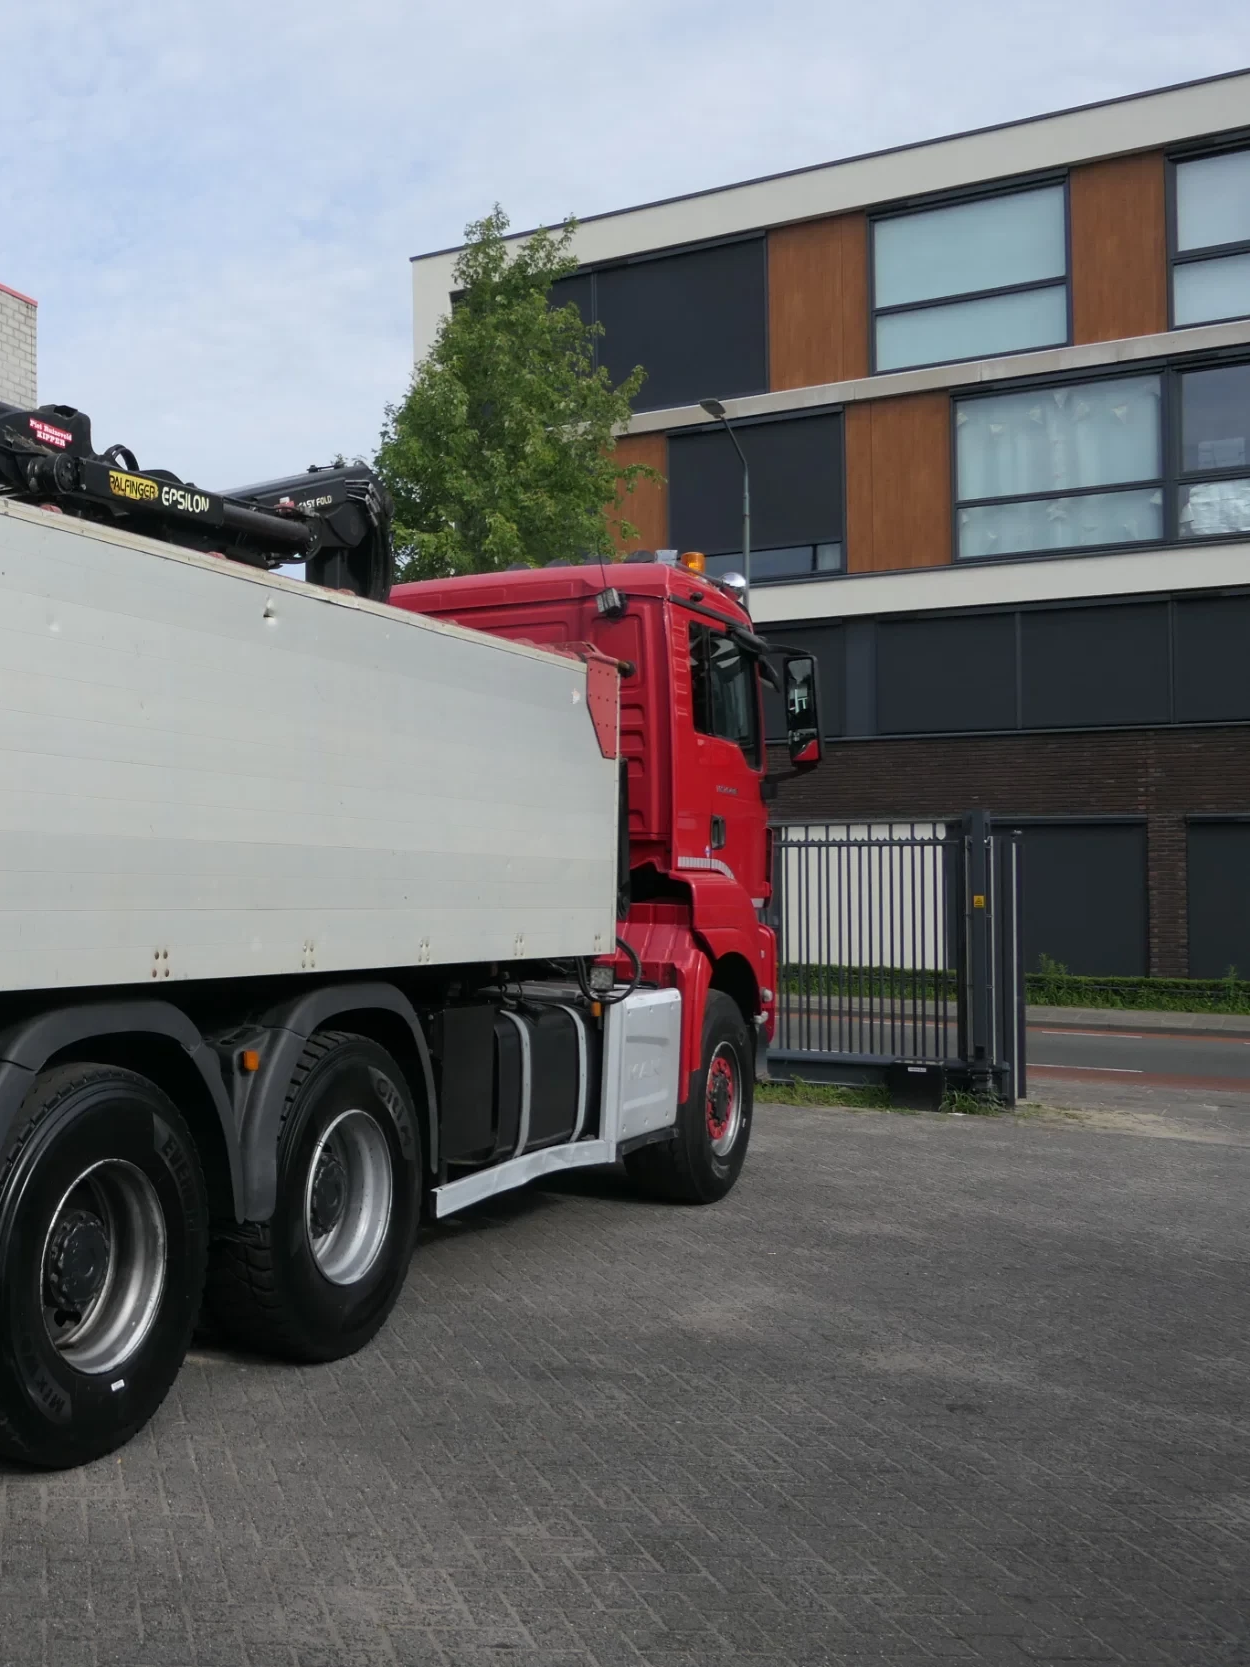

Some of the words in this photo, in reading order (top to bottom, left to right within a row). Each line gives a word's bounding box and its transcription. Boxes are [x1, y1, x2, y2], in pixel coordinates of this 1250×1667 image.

[37, 431, 66, 447] KIPPER
[110, 474, 156, 499] PALFINGER
[162, 486, 210, 513] EPSILON
[316, 495, 332, 506] FOLD
